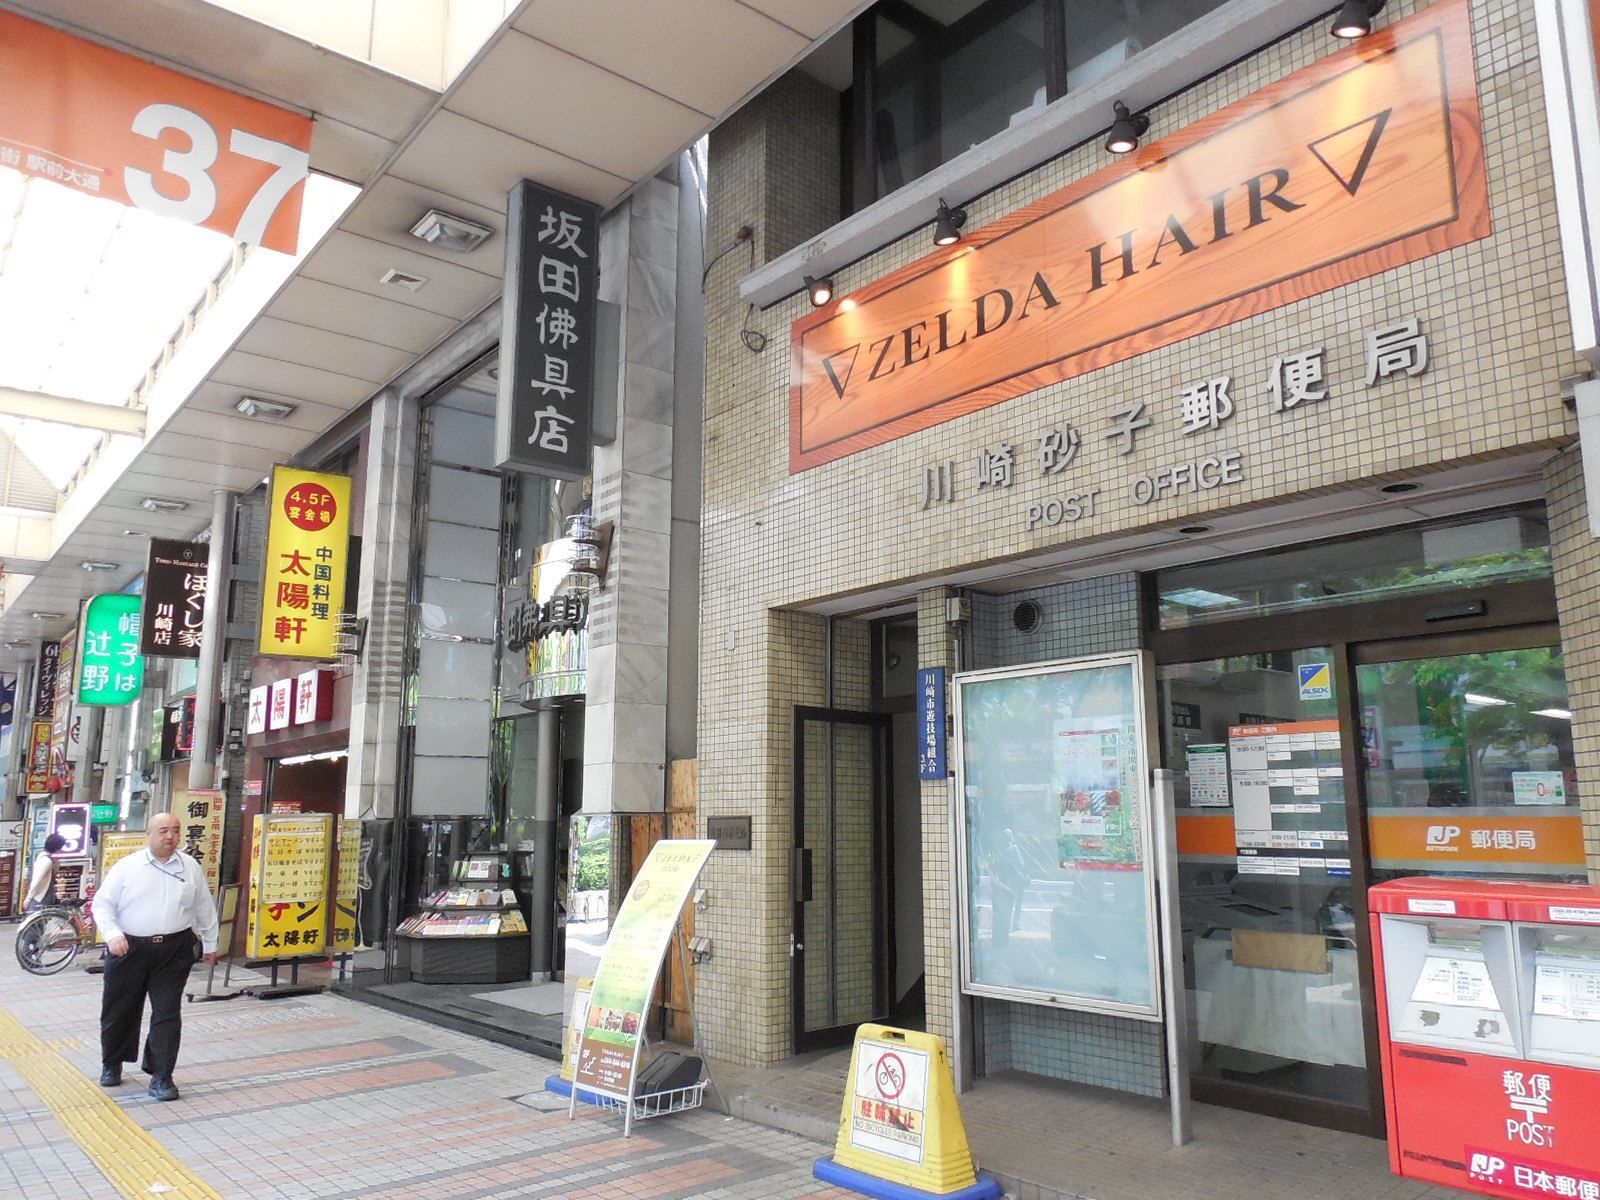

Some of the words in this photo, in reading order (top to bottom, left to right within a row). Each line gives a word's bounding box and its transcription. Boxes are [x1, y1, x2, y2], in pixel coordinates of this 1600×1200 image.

[124, 102, 309, 247] 37
[866, 270, 1060, 383] ZELDA
[1086, 167, 1306, 294] HAIR
[528, 205, 589, 455] 坂田佛具店
[920, 317, 1431, 510] 川崎砂子郵便局
[289, 506, 330, 524] 宴会場
[1026, 490, 1101, 530] POST
[1133, 452, 1244, 506] OFFICE
[273, 549, 312, 644] 太陽軒
[311, 546, 333, 620] 中国料理
[153, 603, 174, 646] 川崎店
[82, 631, 111, 691] 辻野
[115, 612, 141, 692] 帽子は
[1302, 687, 1329, 695] ALSOK
[925, 673, 937, 773] 川崎市遊技場組合
[920, 754, 927, 773] 3F
[1471, 830, 1536, 849] 郵便局
[263, 929, 319, 948] 太陽軒
[1502, 1070, 1552, 1102] 郵便
[861, 1099, 915, 1129] 駐輪禁止
[1506, 1118, 1555, 1148] POST
[1513, 1165, 1600, 1200] 日本郵便
